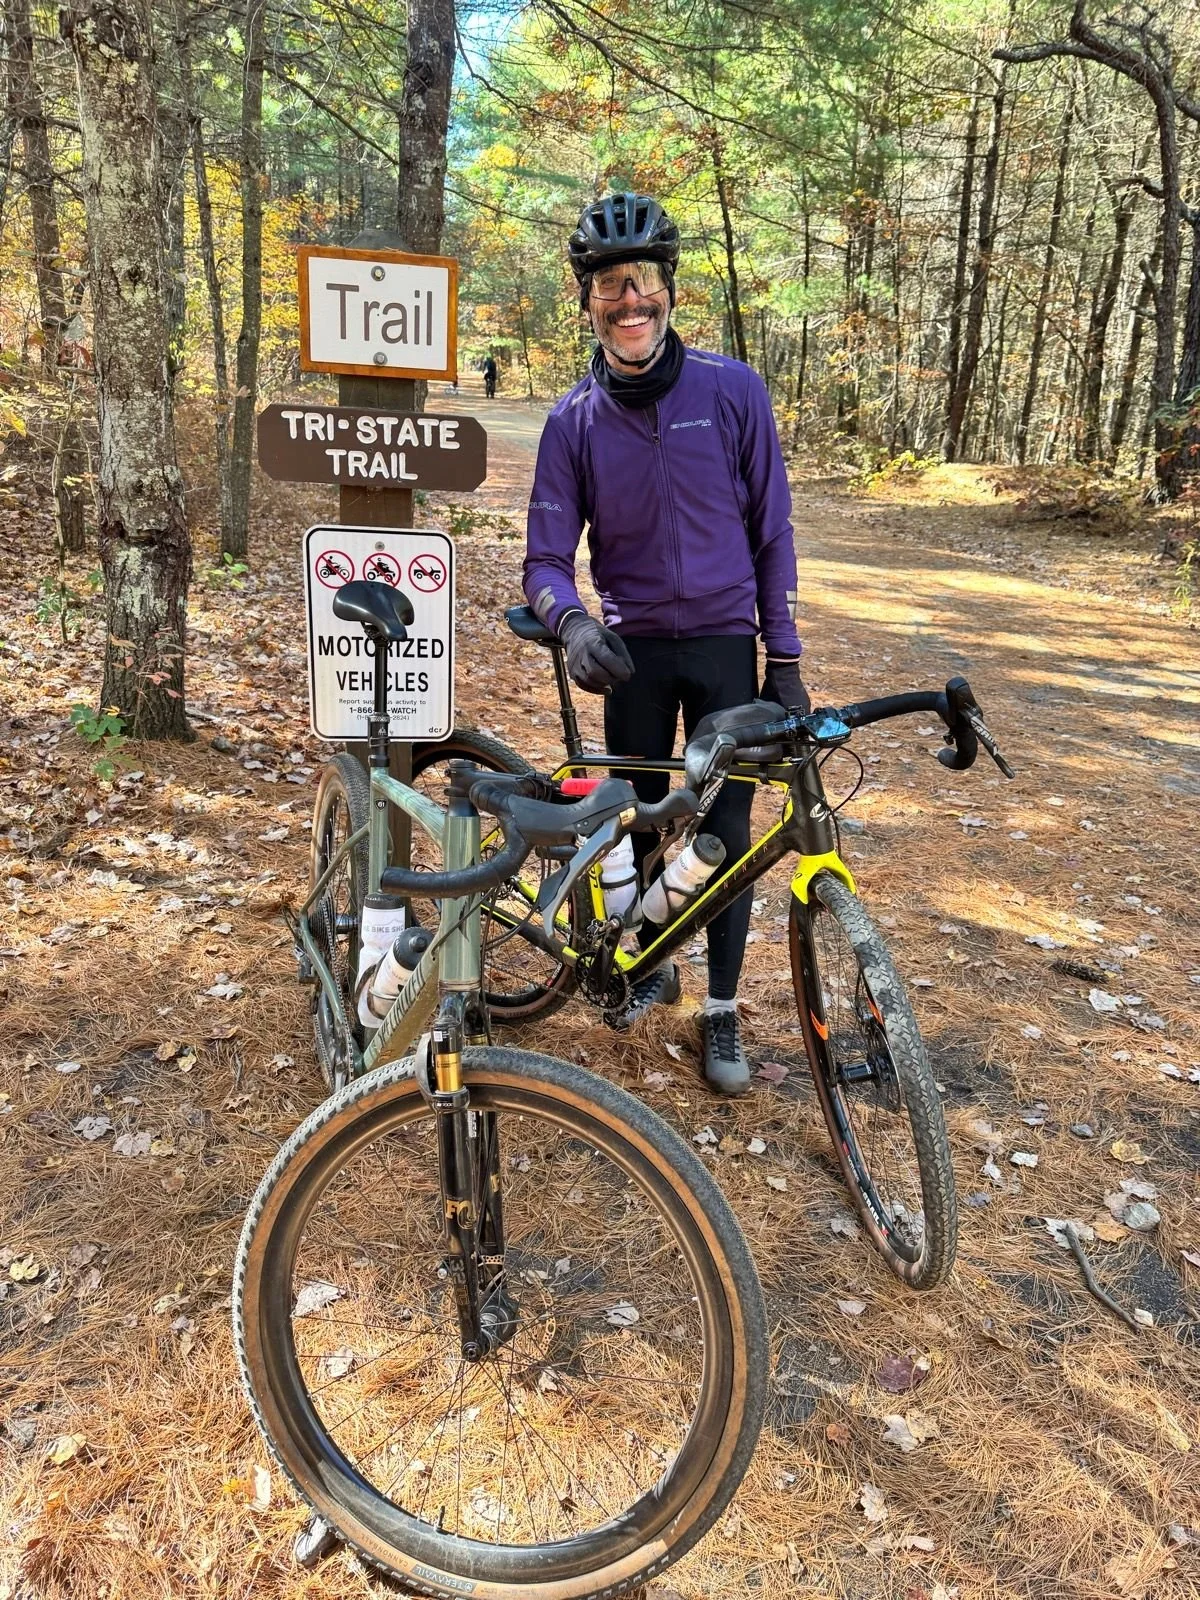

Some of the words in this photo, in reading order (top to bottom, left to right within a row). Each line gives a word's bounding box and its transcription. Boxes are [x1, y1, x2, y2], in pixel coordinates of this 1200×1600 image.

[326, 283, 433, 346] Trail
[325, 448, 418, 480] TRAIL
[428, 726, 442, 734] dcr
[416, 1565, 467, 1591] TERAVAIL
